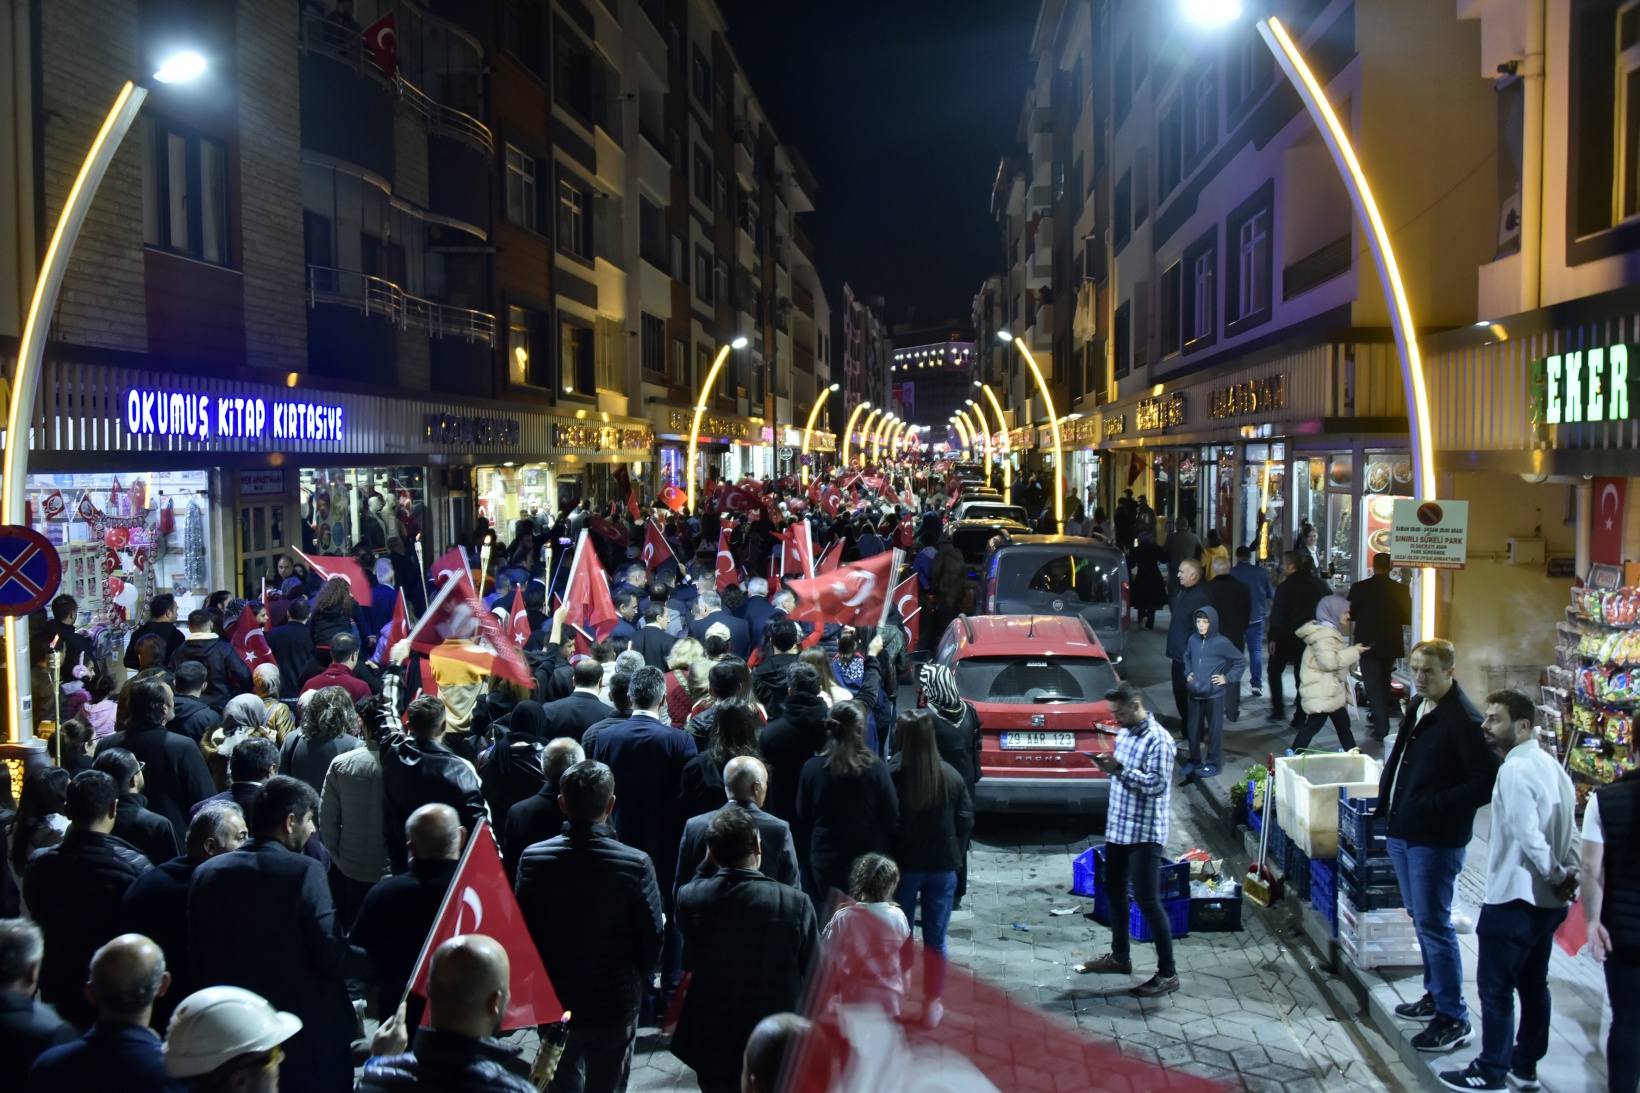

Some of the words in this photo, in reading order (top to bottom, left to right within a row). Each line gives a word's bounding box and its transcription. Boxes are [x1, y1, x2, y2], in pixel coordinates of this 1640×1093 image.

[128, 389, 209, 441] OKUMUŞ
[1420, 536, 1443, 544] SÜRELİ
[1008, 733, 1020, 744] 29
[1027, 733, 1046, 745] AAR
[1053, 734, 1072, 745] 123
